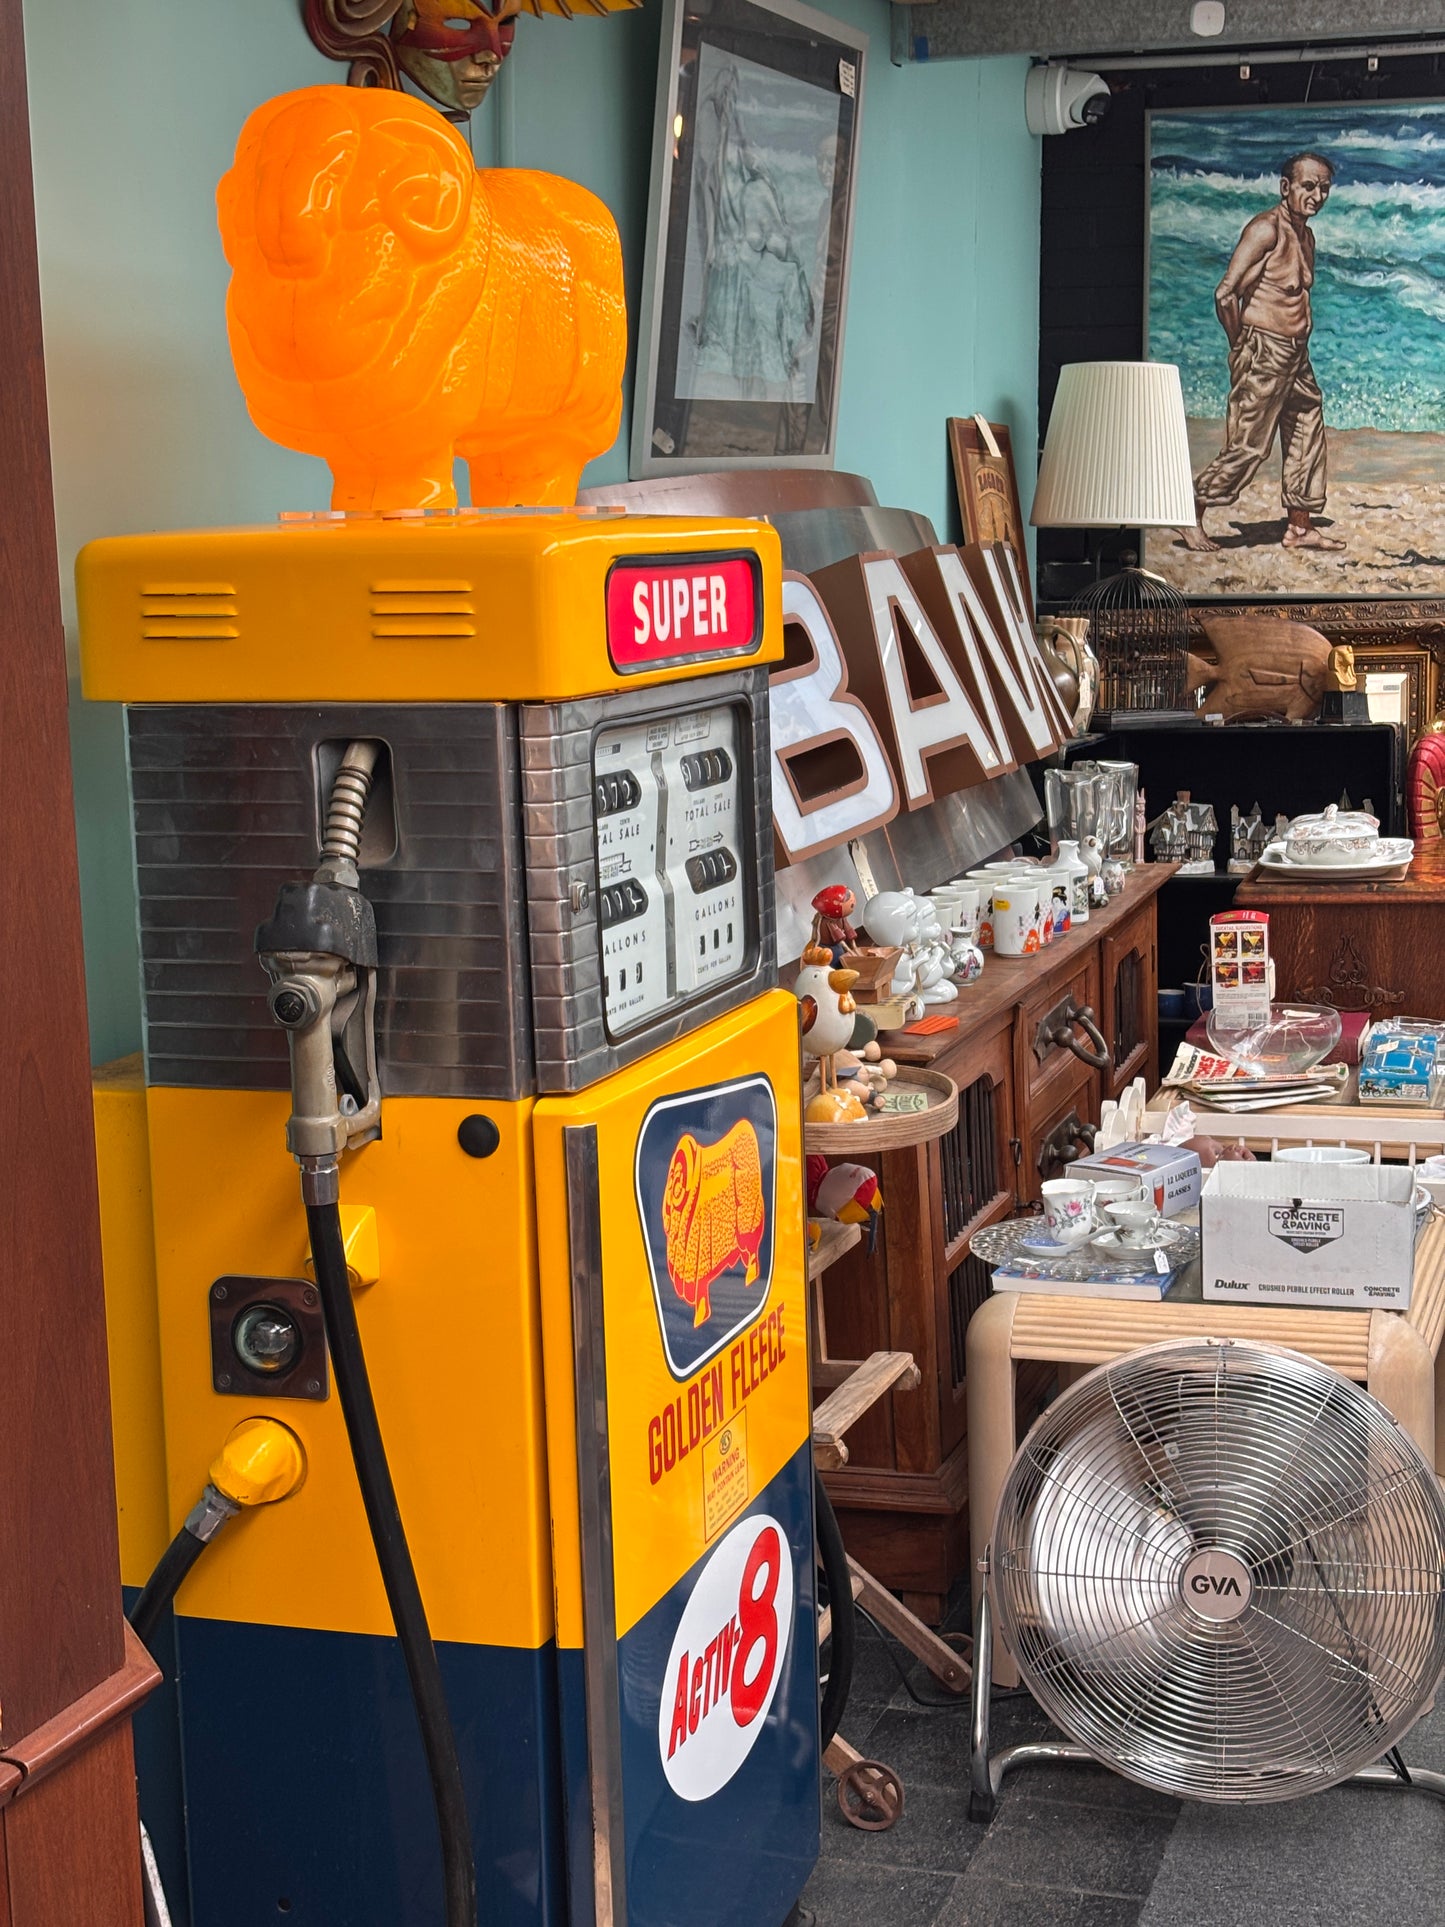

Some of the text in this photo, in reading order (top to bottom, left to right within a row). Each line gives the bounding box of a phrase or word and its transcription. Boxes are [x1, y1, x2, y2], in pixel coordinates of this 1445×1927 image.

[633, 575, 728, 645] SUPER
[769, 543, 1075, 860] BANK
[685, 806, 709, 822] TOTAL
[713, 799, 731, 814] SALE
[619, 824, 639, 841] SALE
[695, 896, 735, 921] GALLONS
[604, 930, 646, 957] ALLONS
[1175, 1167, 1198, 1182] LIQUEUR
[1168, 1184, 1191, 1199] GLASSES
[1273, 1211, 1339, 1222] CONCRETE
[1282, 1220, 1331, 1231] &PAVING
[1214, 1279, 1400, 1296] Dulux CRUSHED PEBBLE EFFECT ROLLER CONCRETE
[648, 1302, 787, 1486] GOLDEN FLEECE
[712, 1447, 740, 1484] WARNING
[1191, 1575, 1241, 1597] GVA
